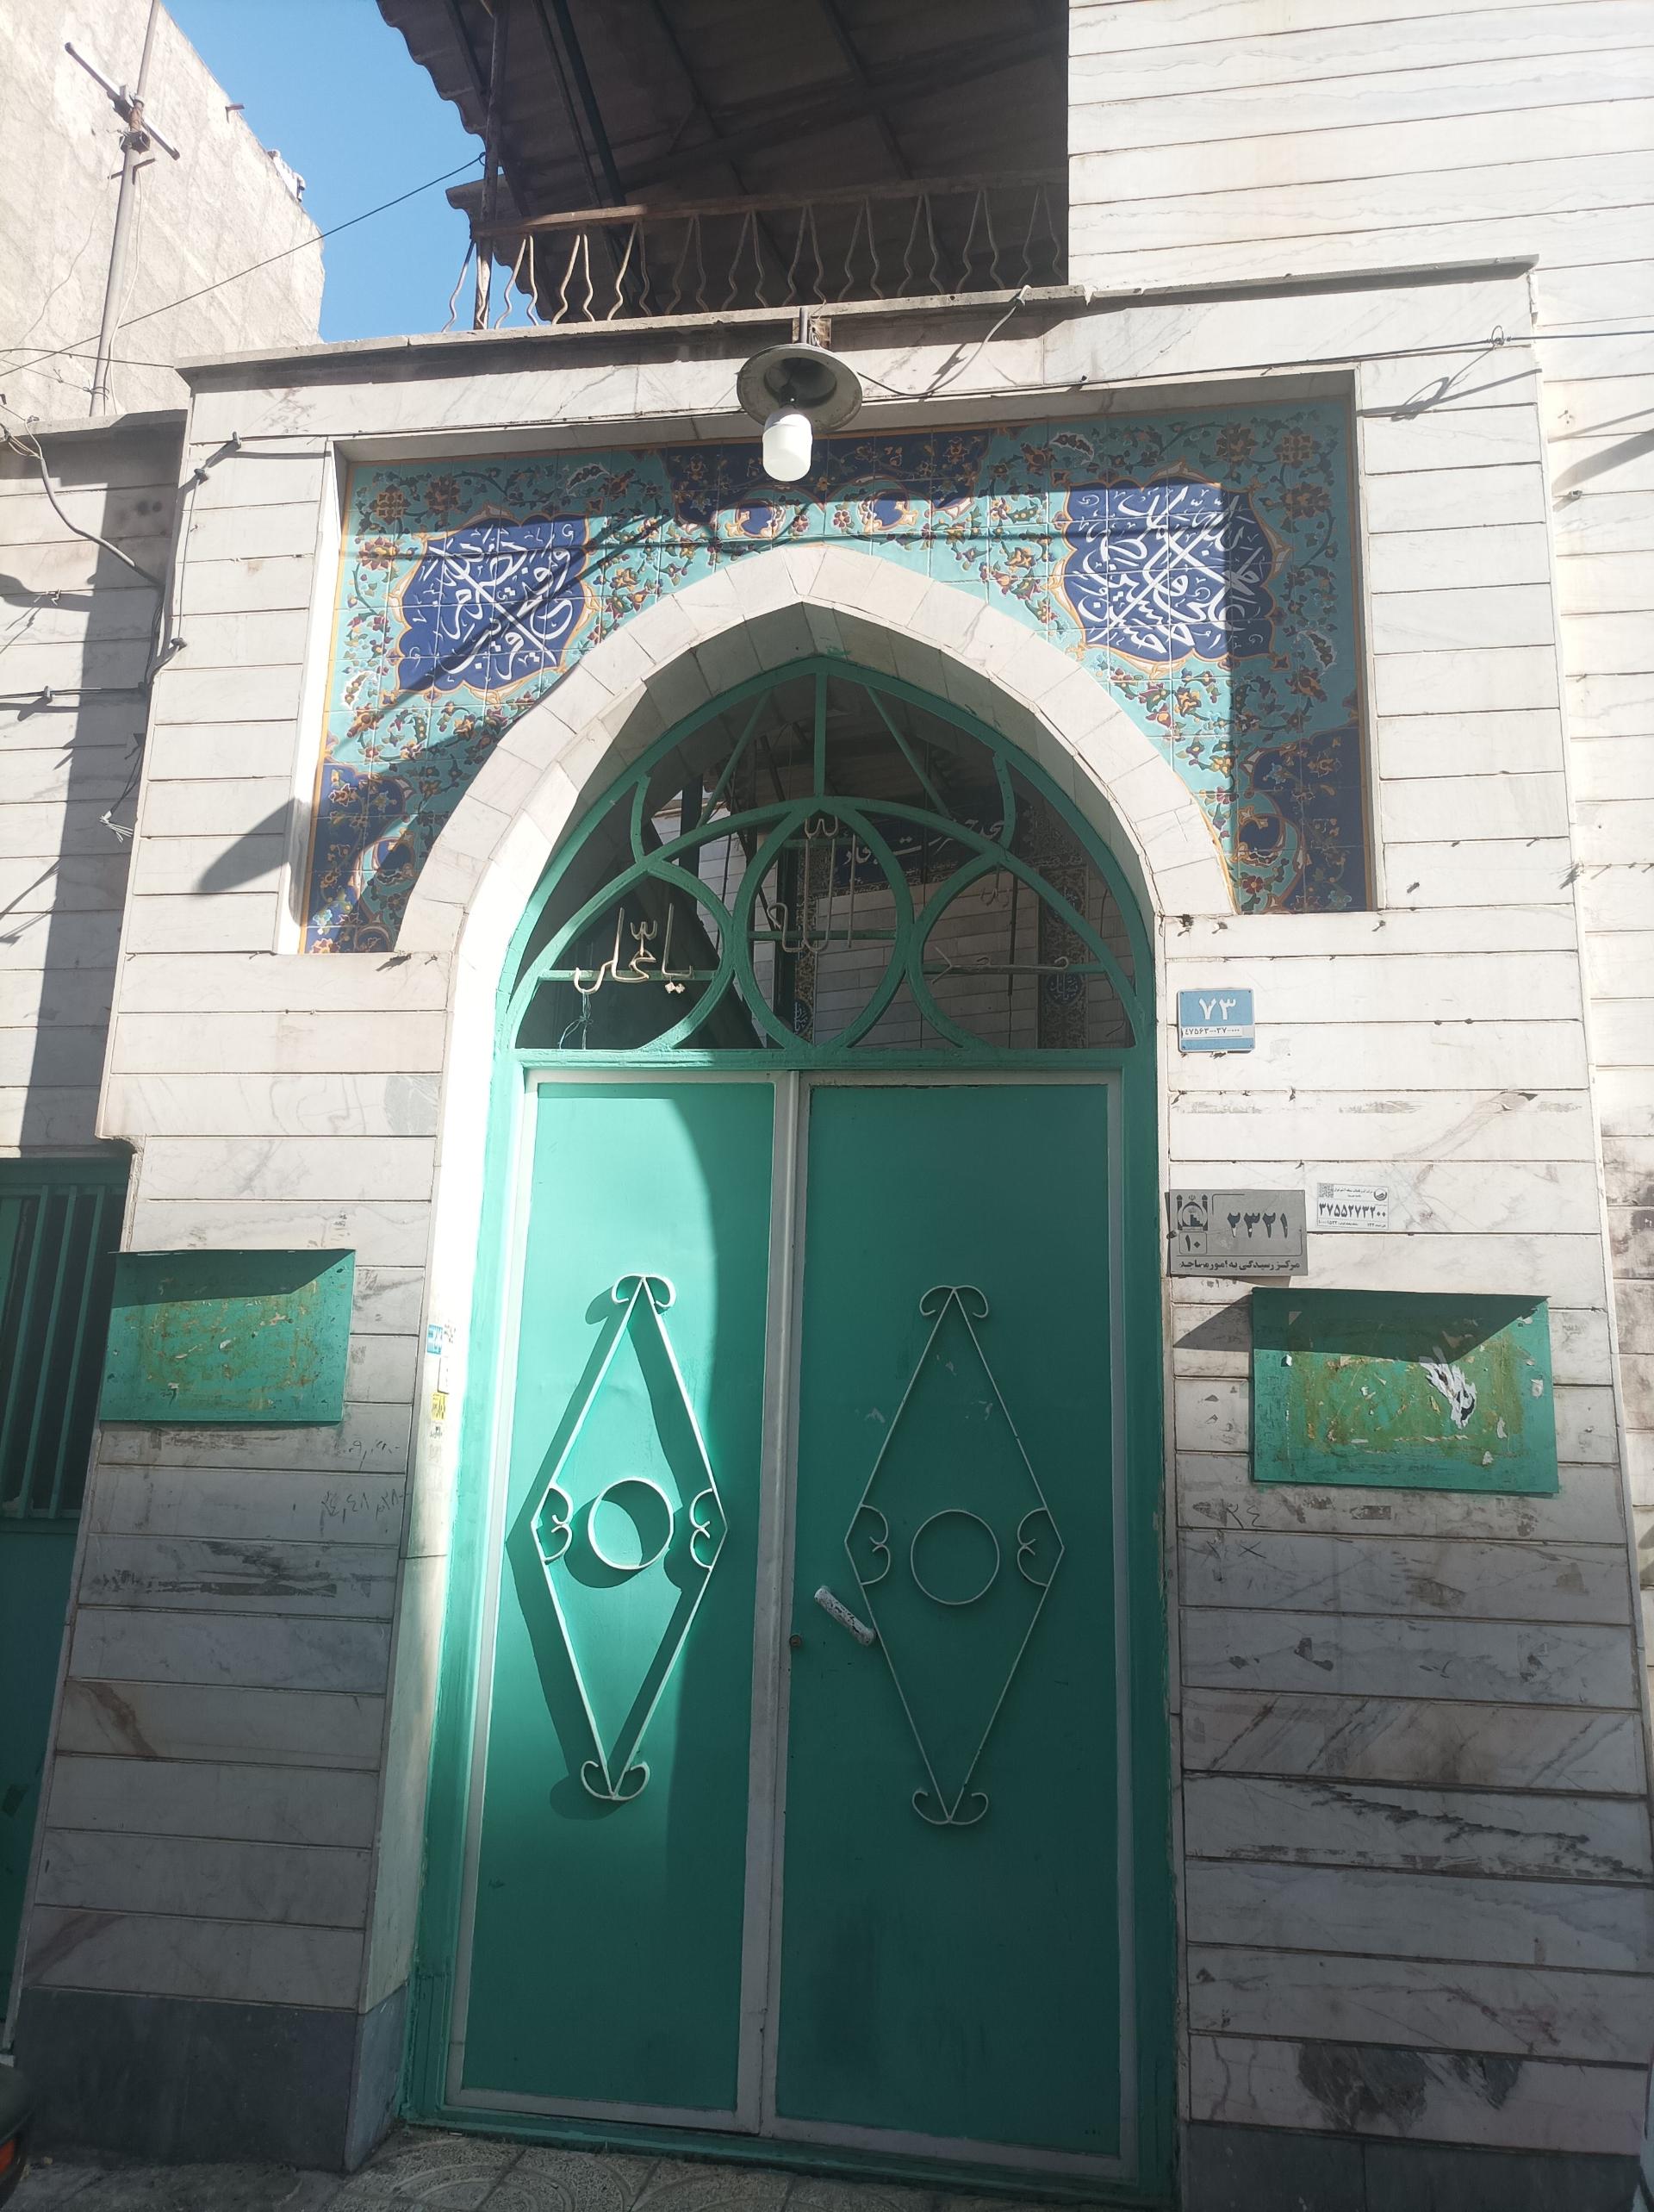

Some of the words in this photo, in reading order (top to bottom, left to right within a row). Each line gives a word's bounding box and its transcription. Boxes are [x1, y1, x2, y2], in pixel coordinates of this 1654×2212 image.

[1198, 998, 1237, 1020] ۷۳
[1319, 1202, 1386, 1219] ۳۷۵۵۲۷۳۲۰۰
[1227, 1212, 1289, 1239] ۲۳۲۱
[1185, 1234, 1201, 1253] ۱۰
[1276, 1260, 1301, 1271] مرکز
